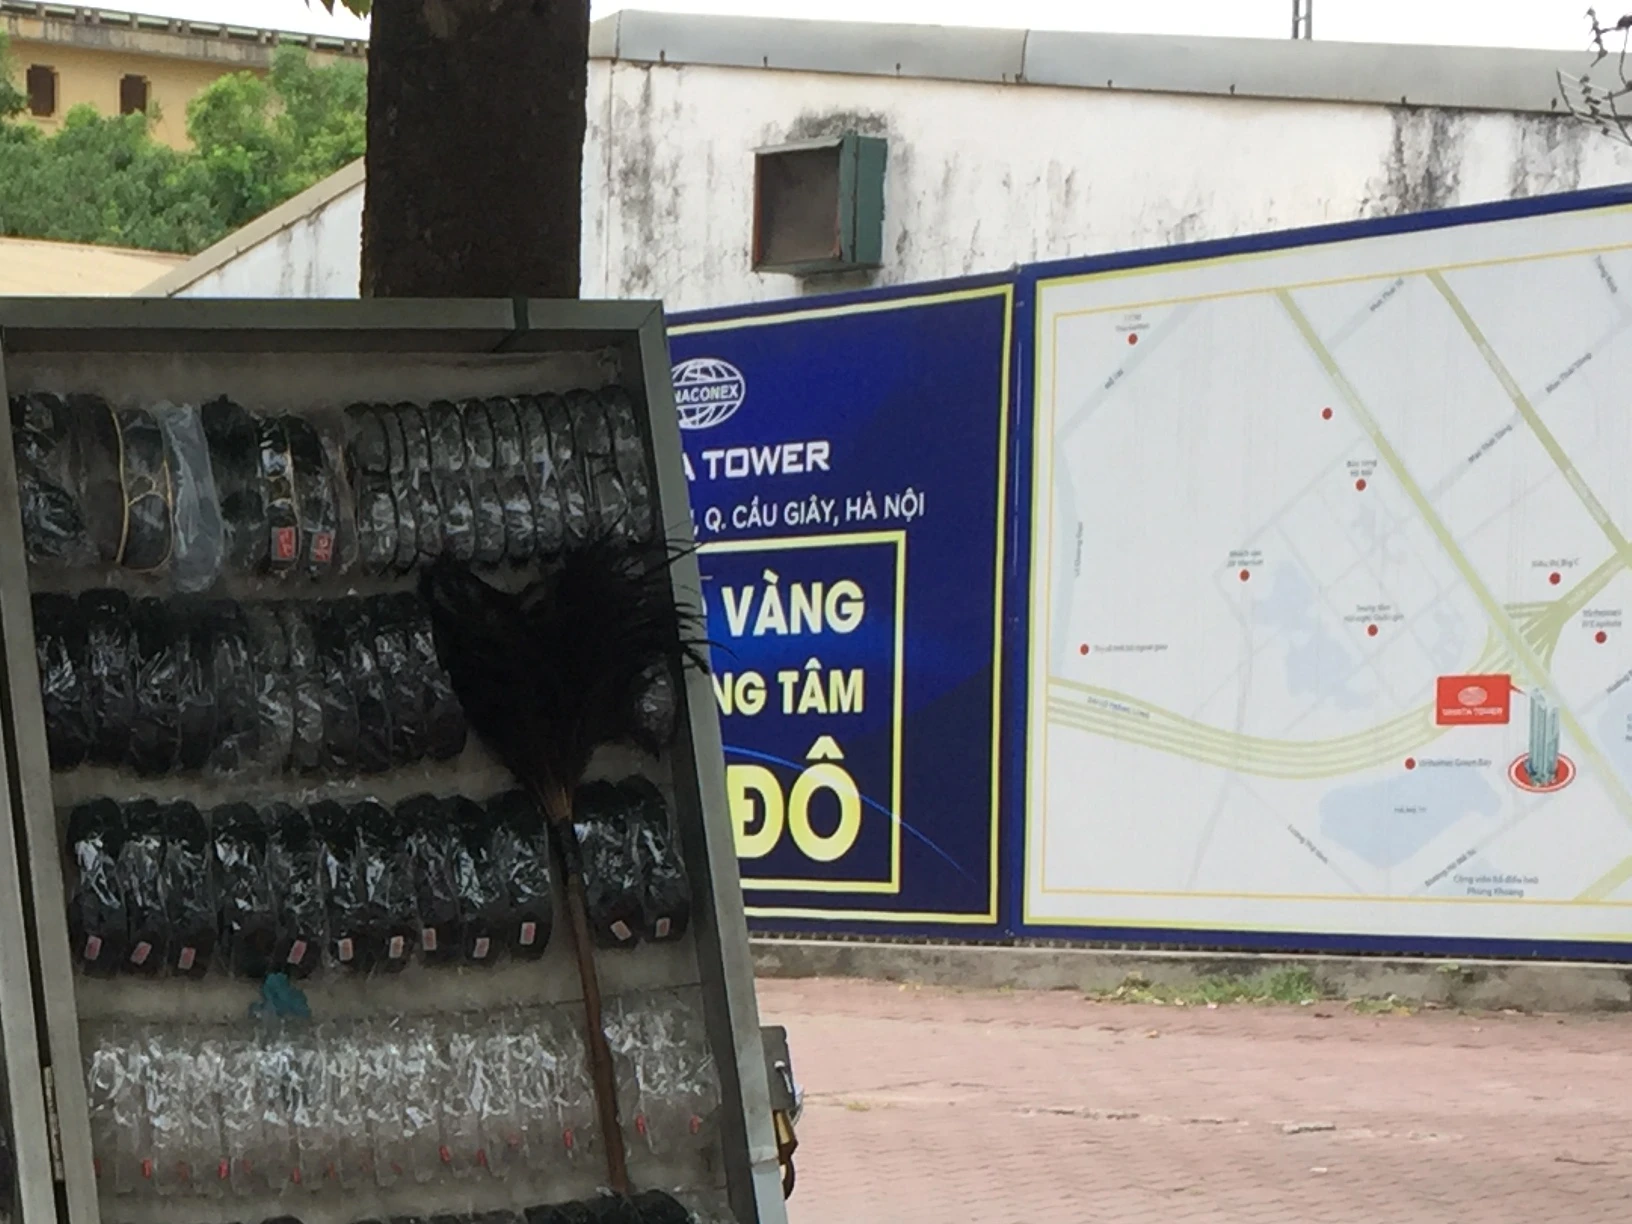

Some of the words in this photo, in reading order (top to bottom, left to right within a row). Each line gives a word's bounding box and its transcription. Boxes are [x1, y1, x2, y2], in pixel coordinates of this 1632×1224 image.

[702, 441, 831, 480] TOWER
[705, 507, 727, 532] Q.
[846, 490, 878, 522] HÀ
[884, 487, 925, 522] NỘI
[721, 569, 865, 637] VÀNG
[777, 657, 865, 715] TÂM
[727, 735, 862, 862] ĐÔ
